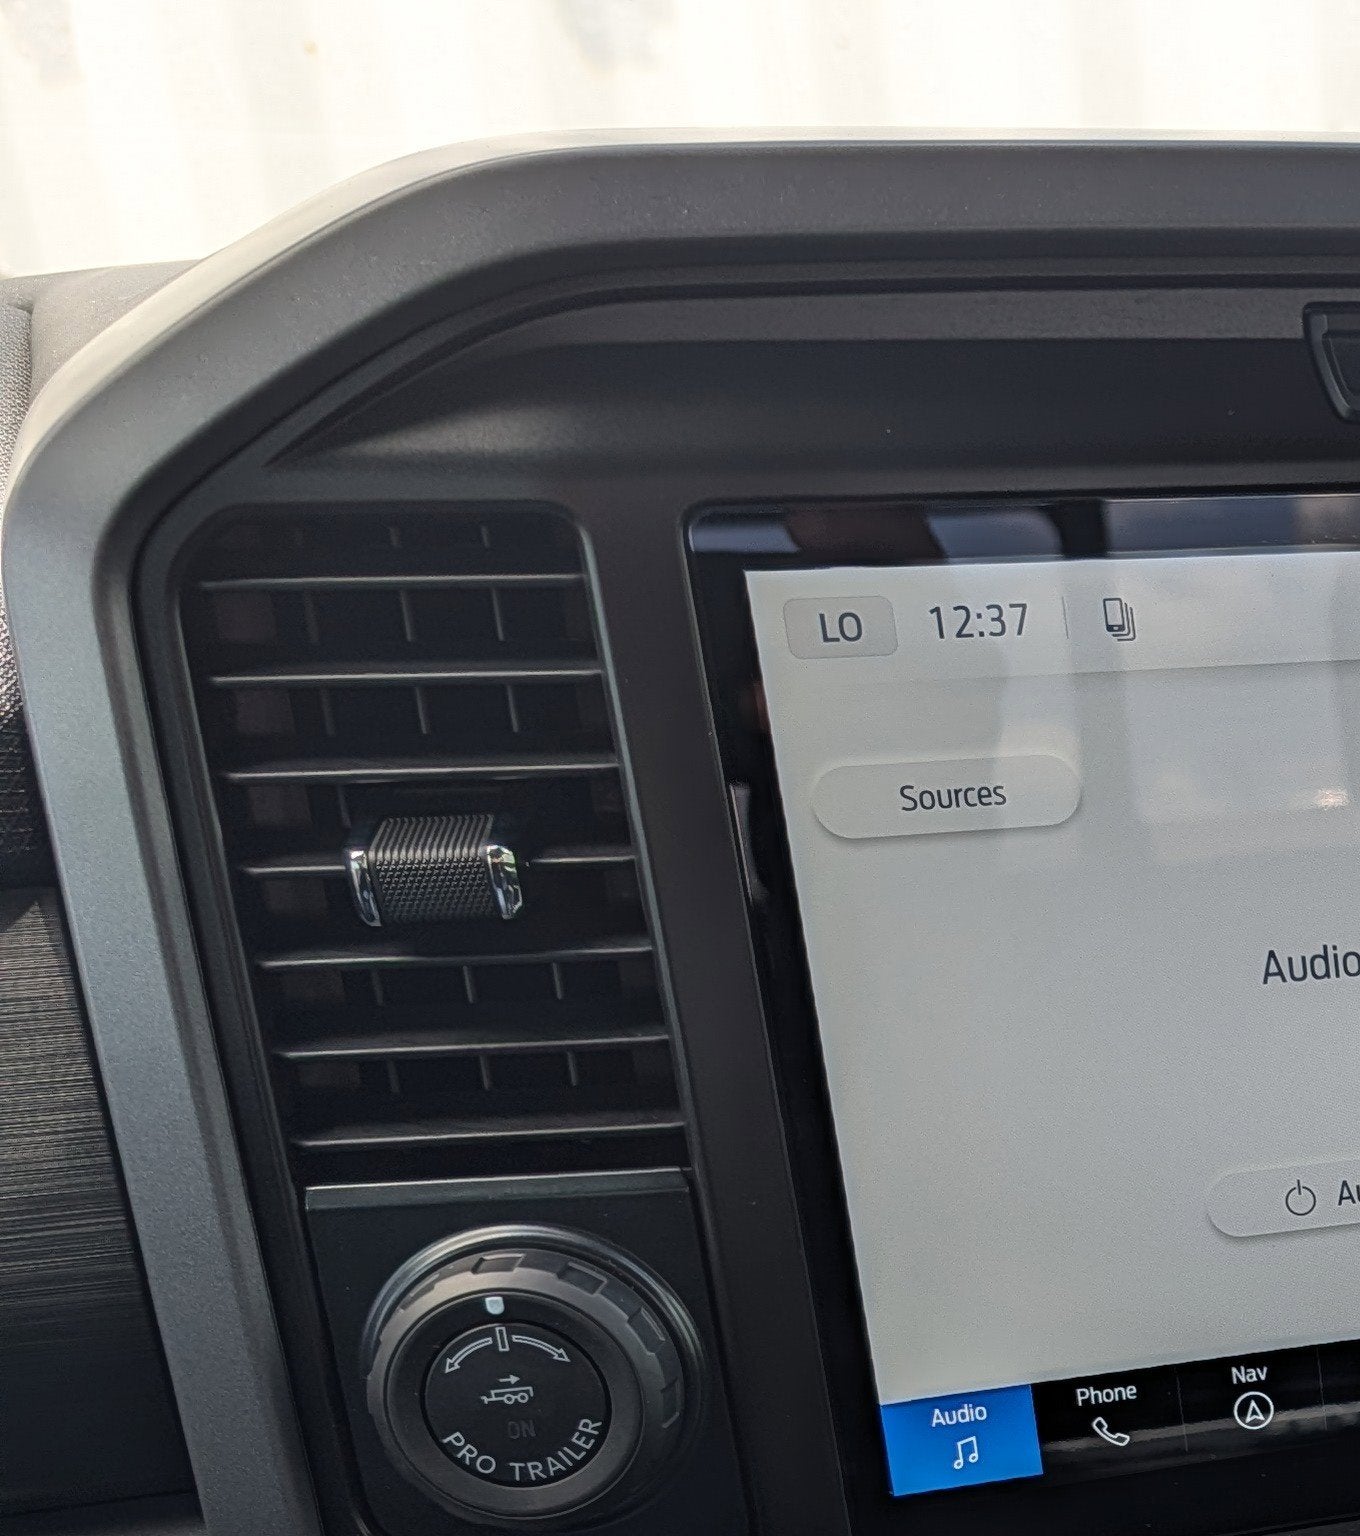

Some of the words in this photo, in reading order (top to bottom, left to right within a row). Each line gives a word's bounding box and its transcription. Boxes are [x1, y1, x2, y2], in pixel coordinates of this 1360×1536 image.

[818, 610, 863, 643] LO
[928, 603, 1029, 640] 12:37
[899, 780, 1007, 812] Sources
[1231, 1363, 1268, 1386] Nav
[1076, 1381, 1138, 1406] Phone
[931, 1403, 988, 1428] Audio
[442, 1431, 497, 1475] PRO
[509, 1418, 604, 1482] TRAILER
